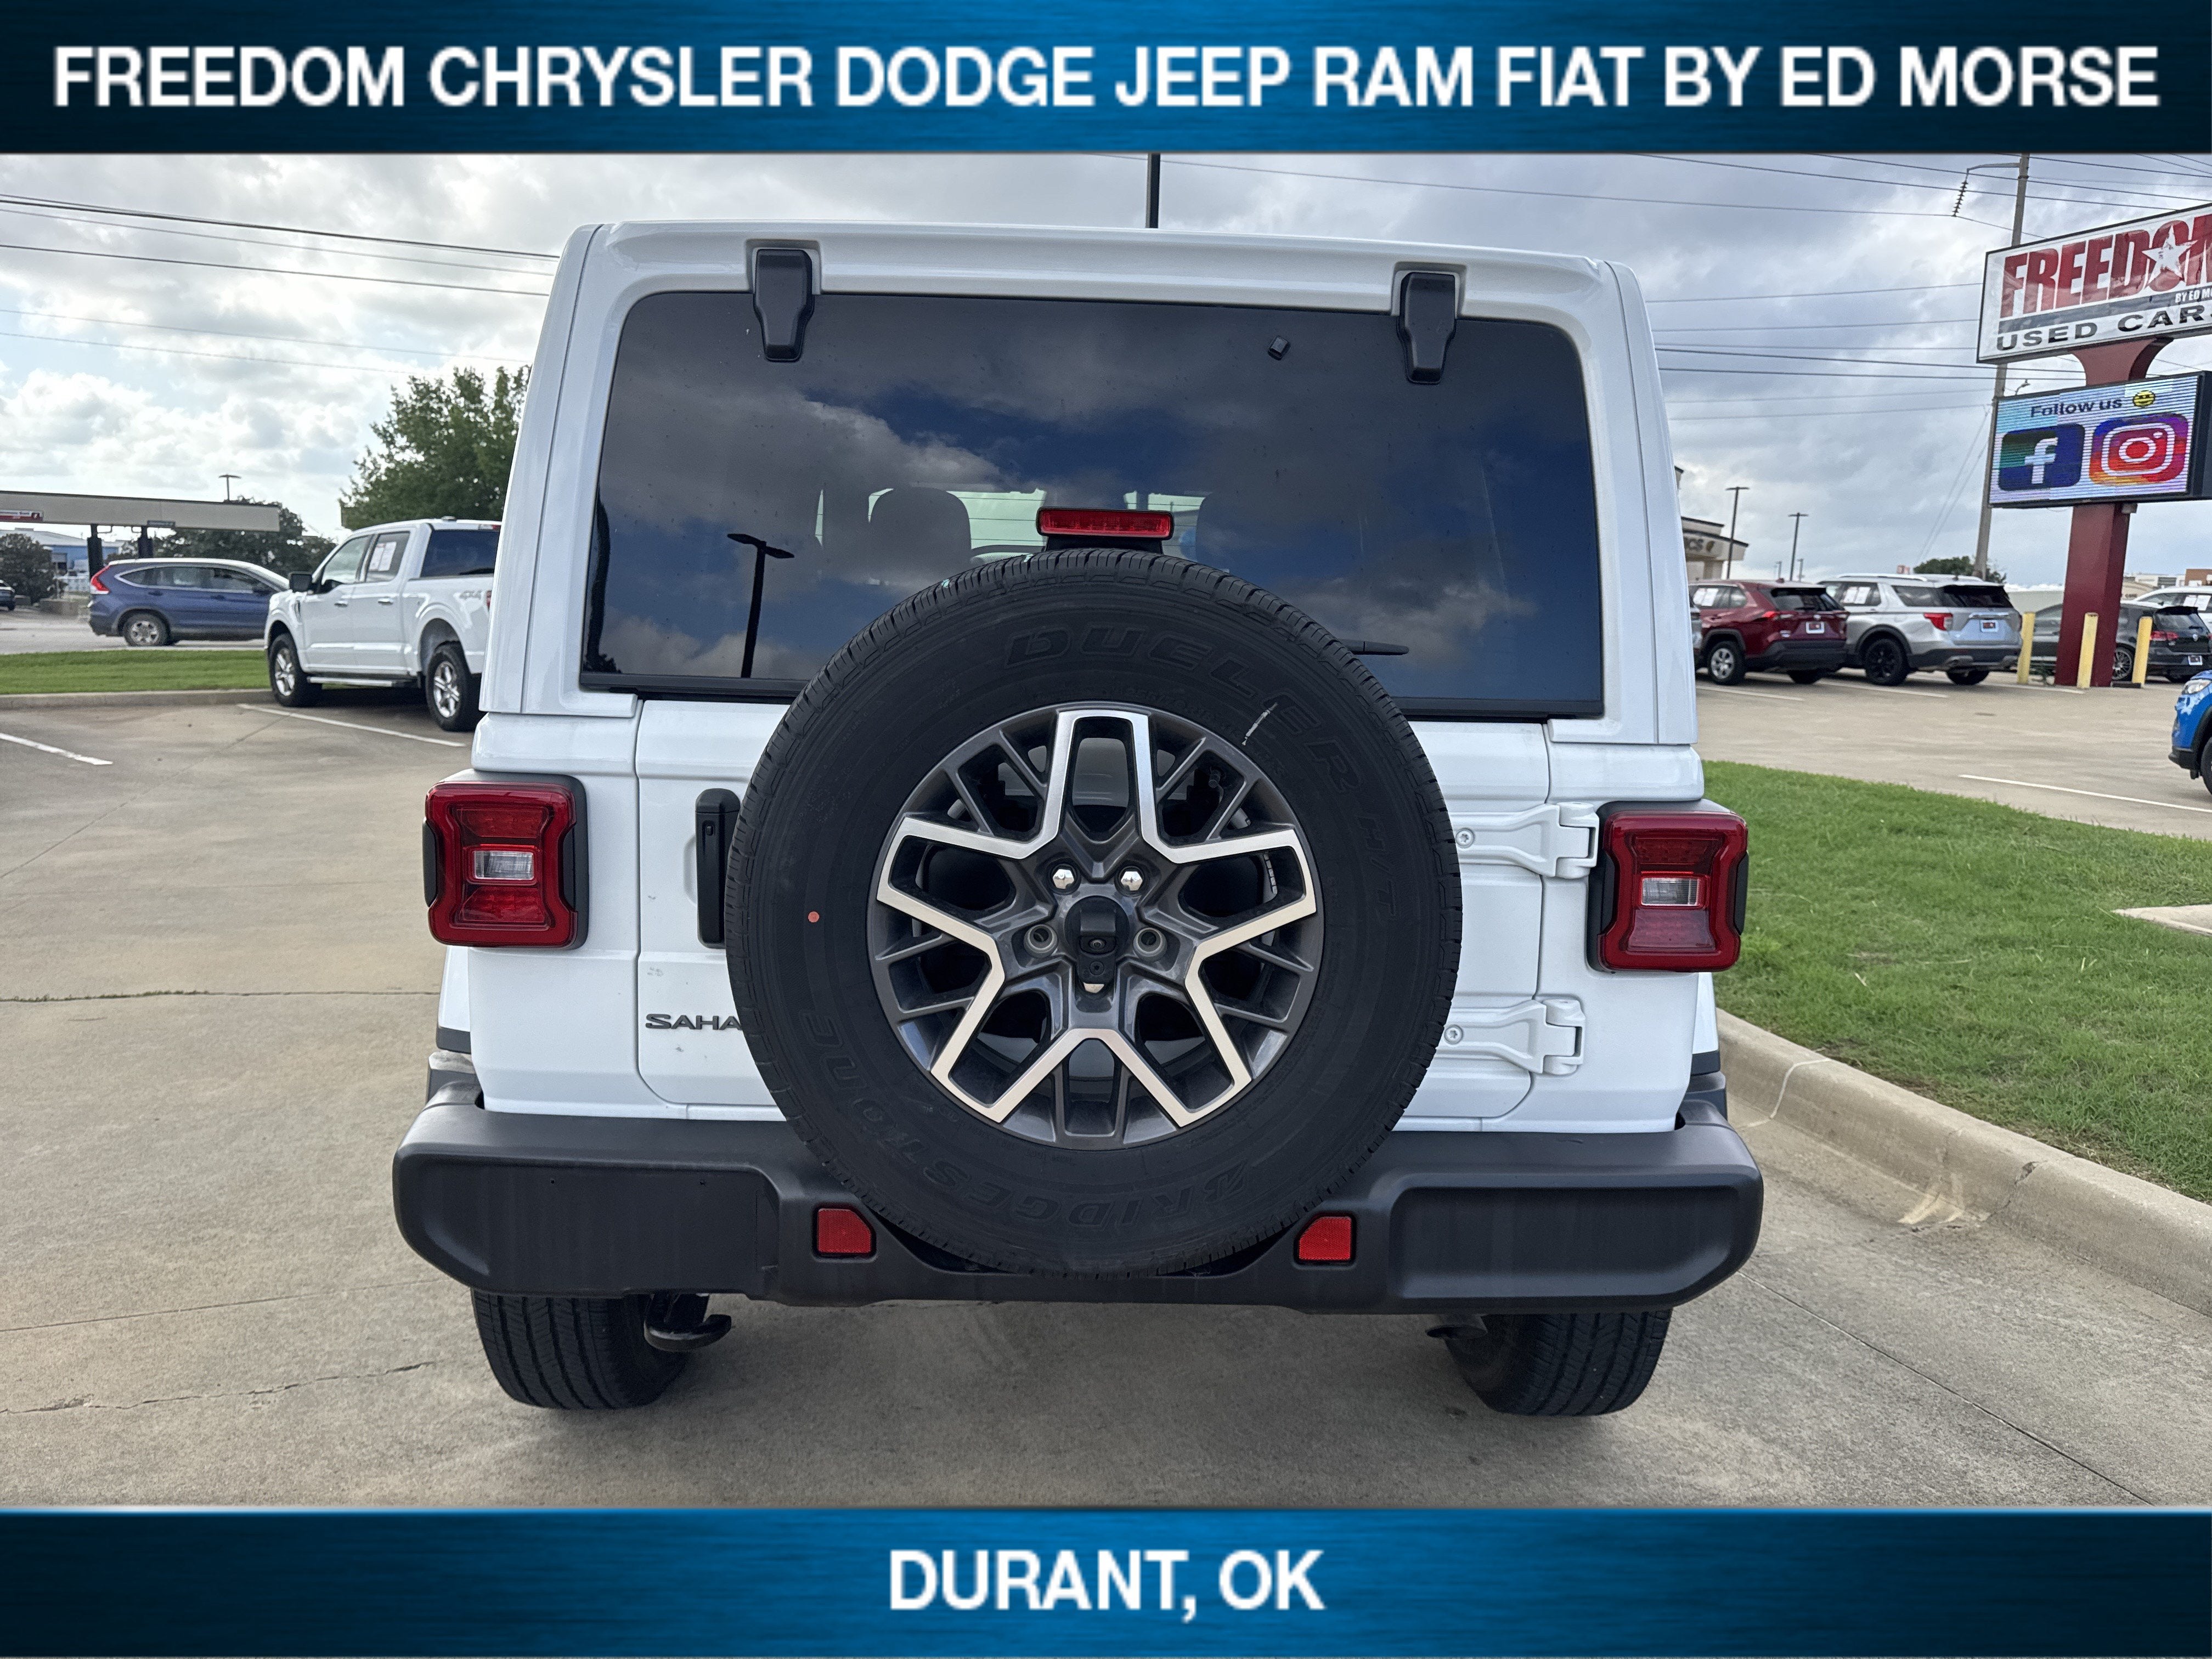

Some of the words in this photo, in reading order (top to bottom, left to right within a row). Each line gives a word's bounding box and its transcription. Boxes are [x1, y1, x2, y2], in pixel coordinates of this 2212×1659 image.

[2175, 291, 2187, 303] BY
[2188, 290, 2200, 301] ED
[2202, 287, 2212, 299] M
[1996, 322, 2098, 351] USED
[2118, 304, 2212, 332] CAR
[2030, 401, 2095, 417] Follow
[2099, 399, 2122, 410] us
[997, 620, 1363, 794] DUELER
[799, 1009, 1250, 1230] BRIDGESTONE
